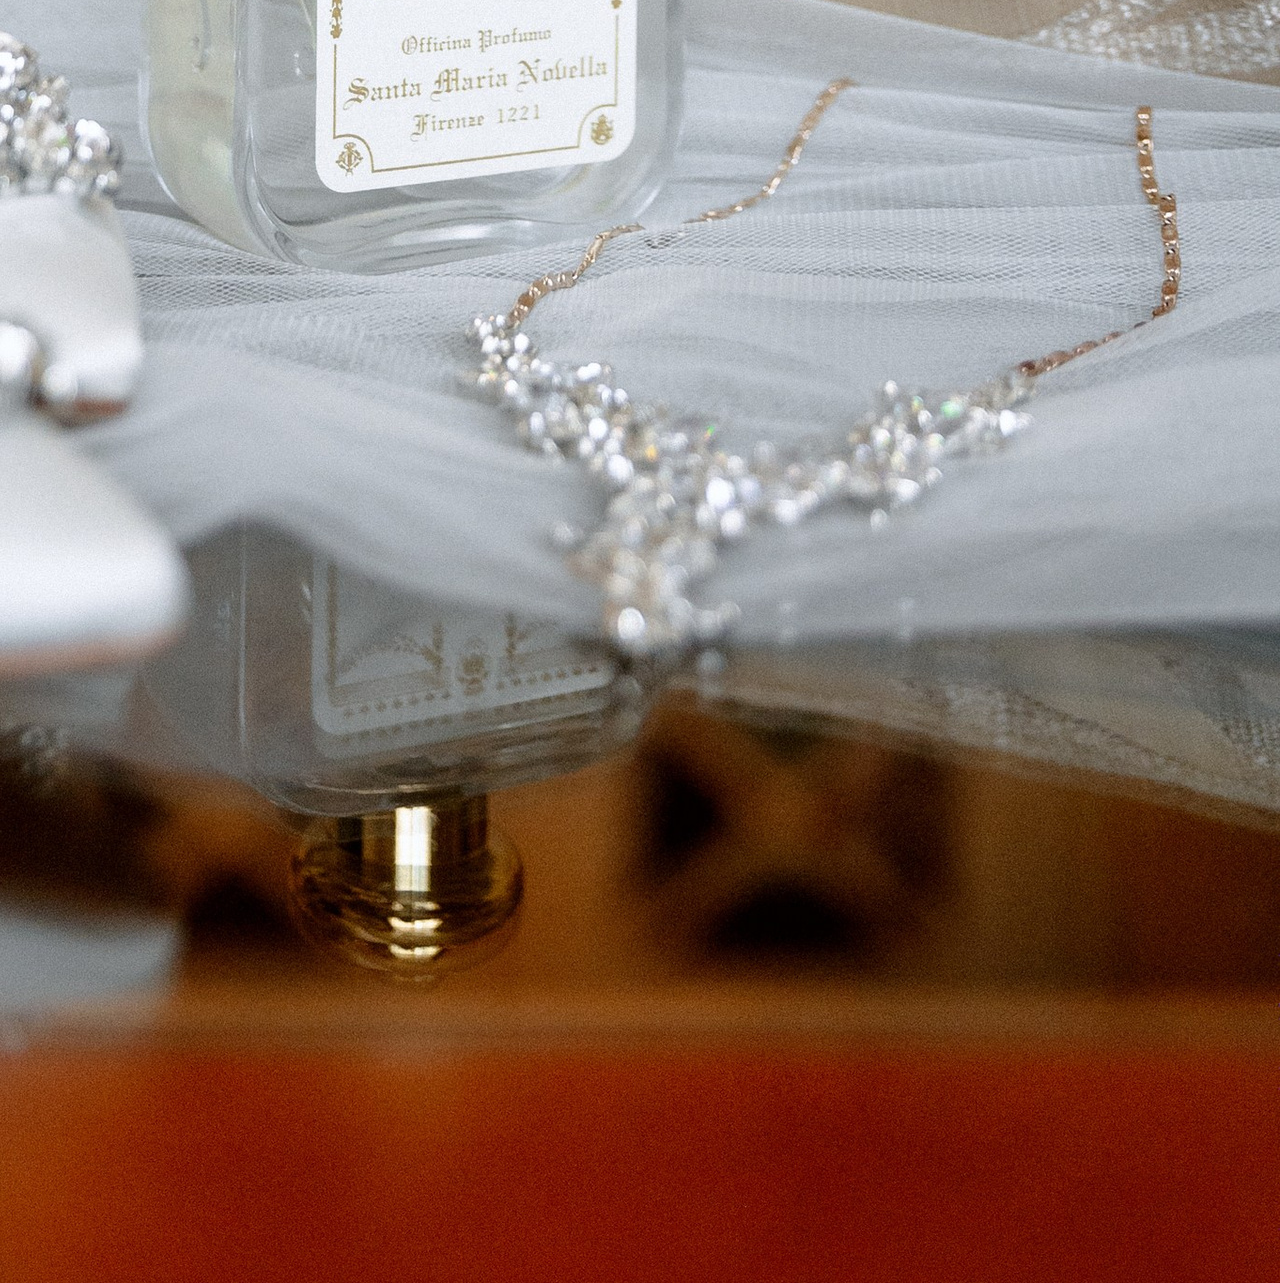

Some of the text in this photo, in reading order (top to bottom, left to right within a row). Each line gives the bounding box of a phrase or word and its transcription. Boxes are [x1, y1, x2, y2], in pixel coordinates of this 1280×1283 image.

[401, 27, 552, 56] Officina Profumo
[342, 55, 608, 111] Santa Maria Novella
[410, 104, 541, 142] Firenze 1221
